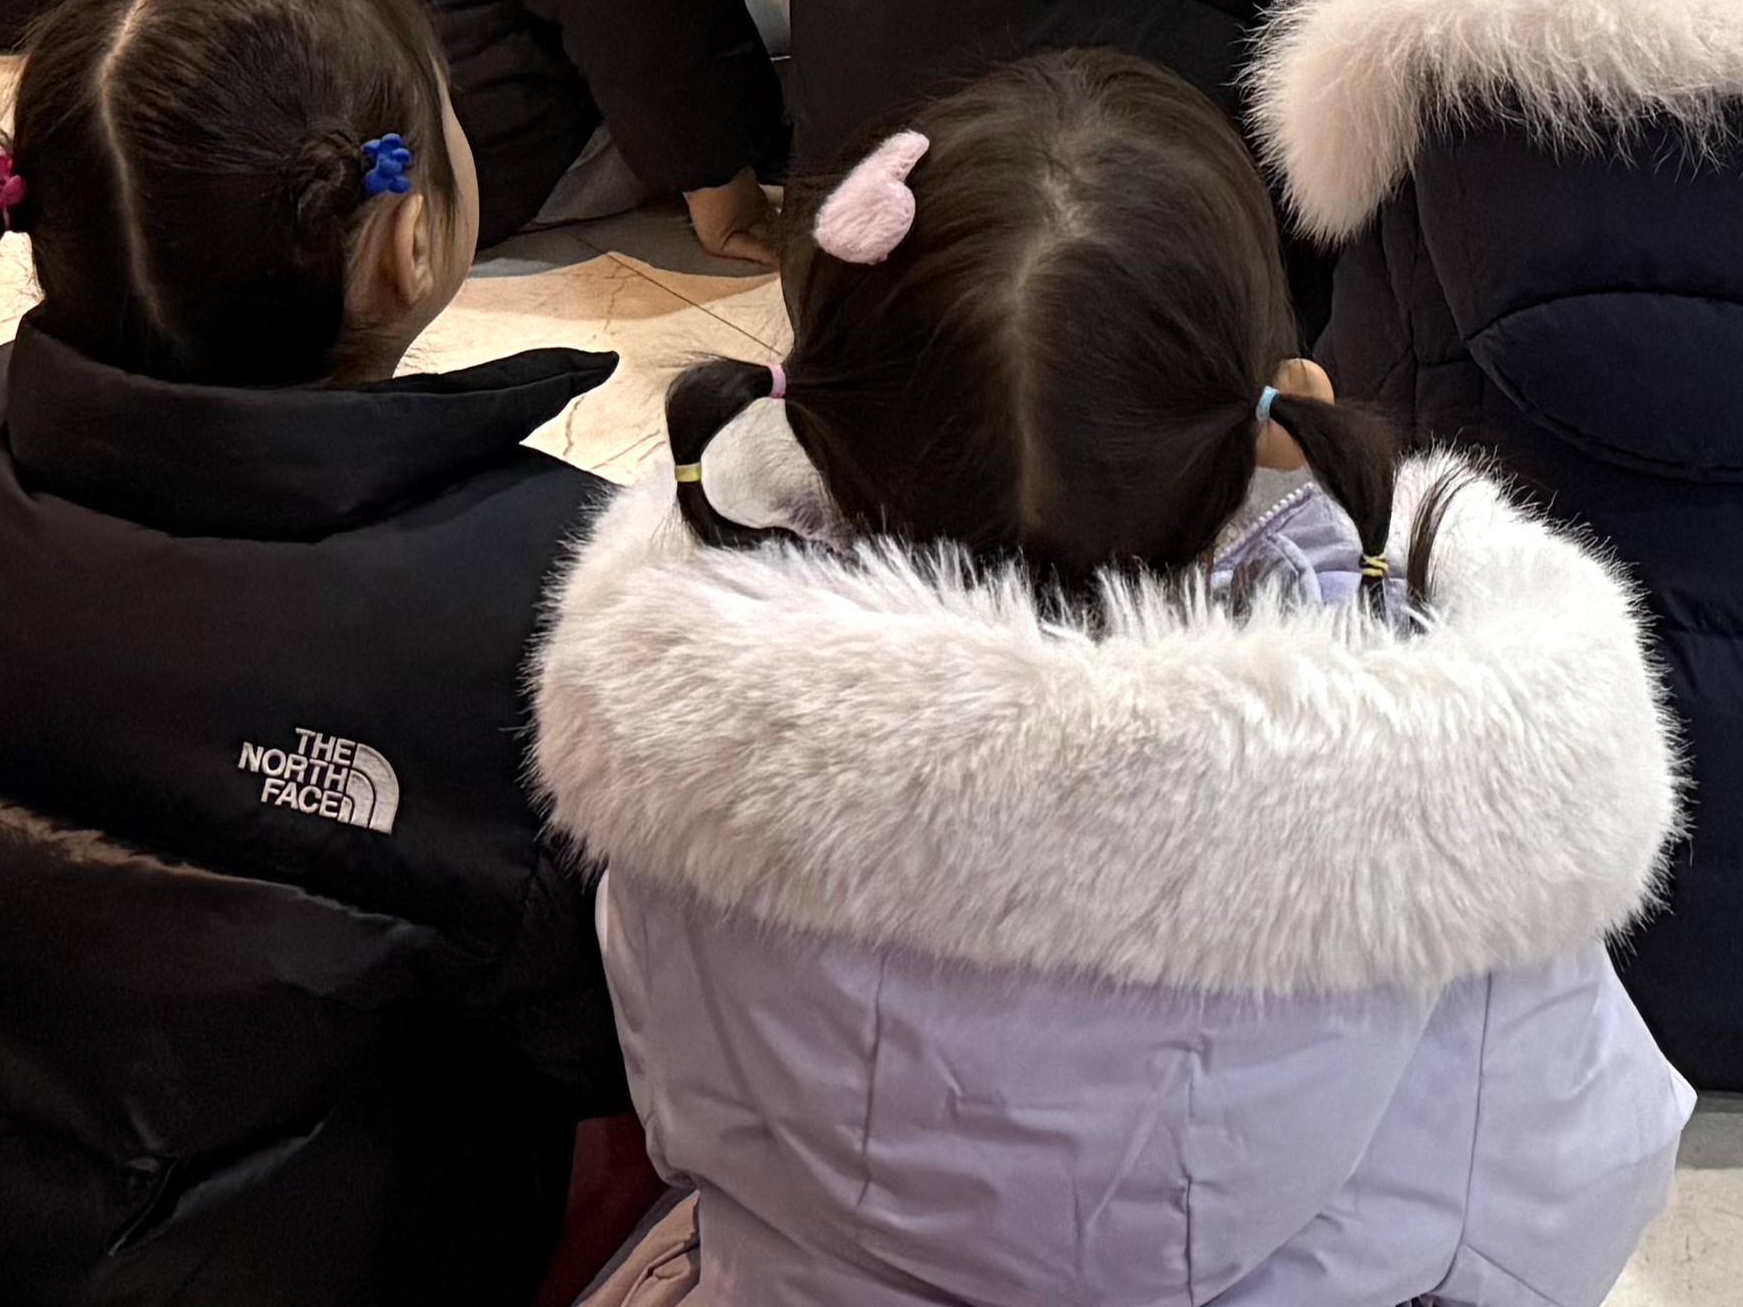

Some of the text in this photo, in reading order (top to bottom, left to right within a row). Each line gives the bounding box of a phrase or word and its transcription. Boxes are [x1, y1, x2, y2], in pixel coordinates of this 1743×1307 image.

[238, 742, 348, 792] NORTH
[295, 727, 358, 768] THE
[261, 777, 343, 818] FACE
